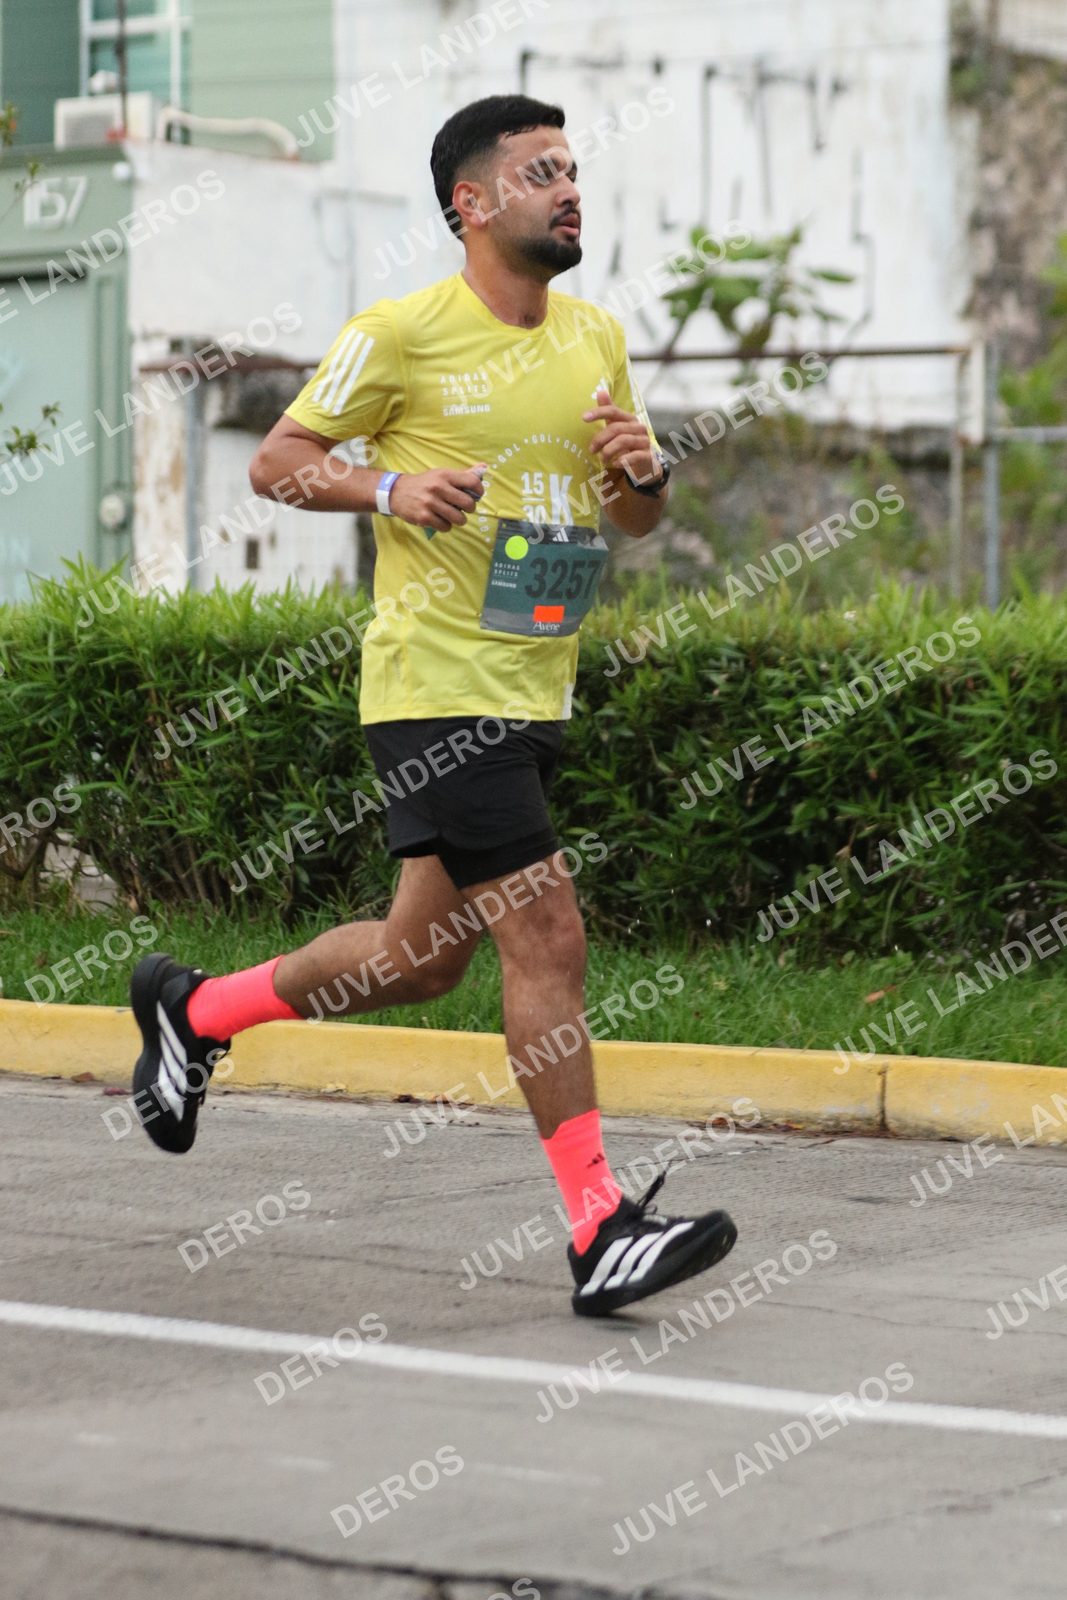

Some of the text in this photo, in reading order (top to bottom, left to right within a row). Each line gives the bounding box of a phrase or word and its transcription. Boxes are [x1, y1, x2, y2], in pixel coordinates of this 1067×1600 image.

[443, 404, 491, 416] SAMSUNG
[521, 472, 545, 495] 15
[549, 473, 574, 527] K
[525, 557, 601, 600] 3257
